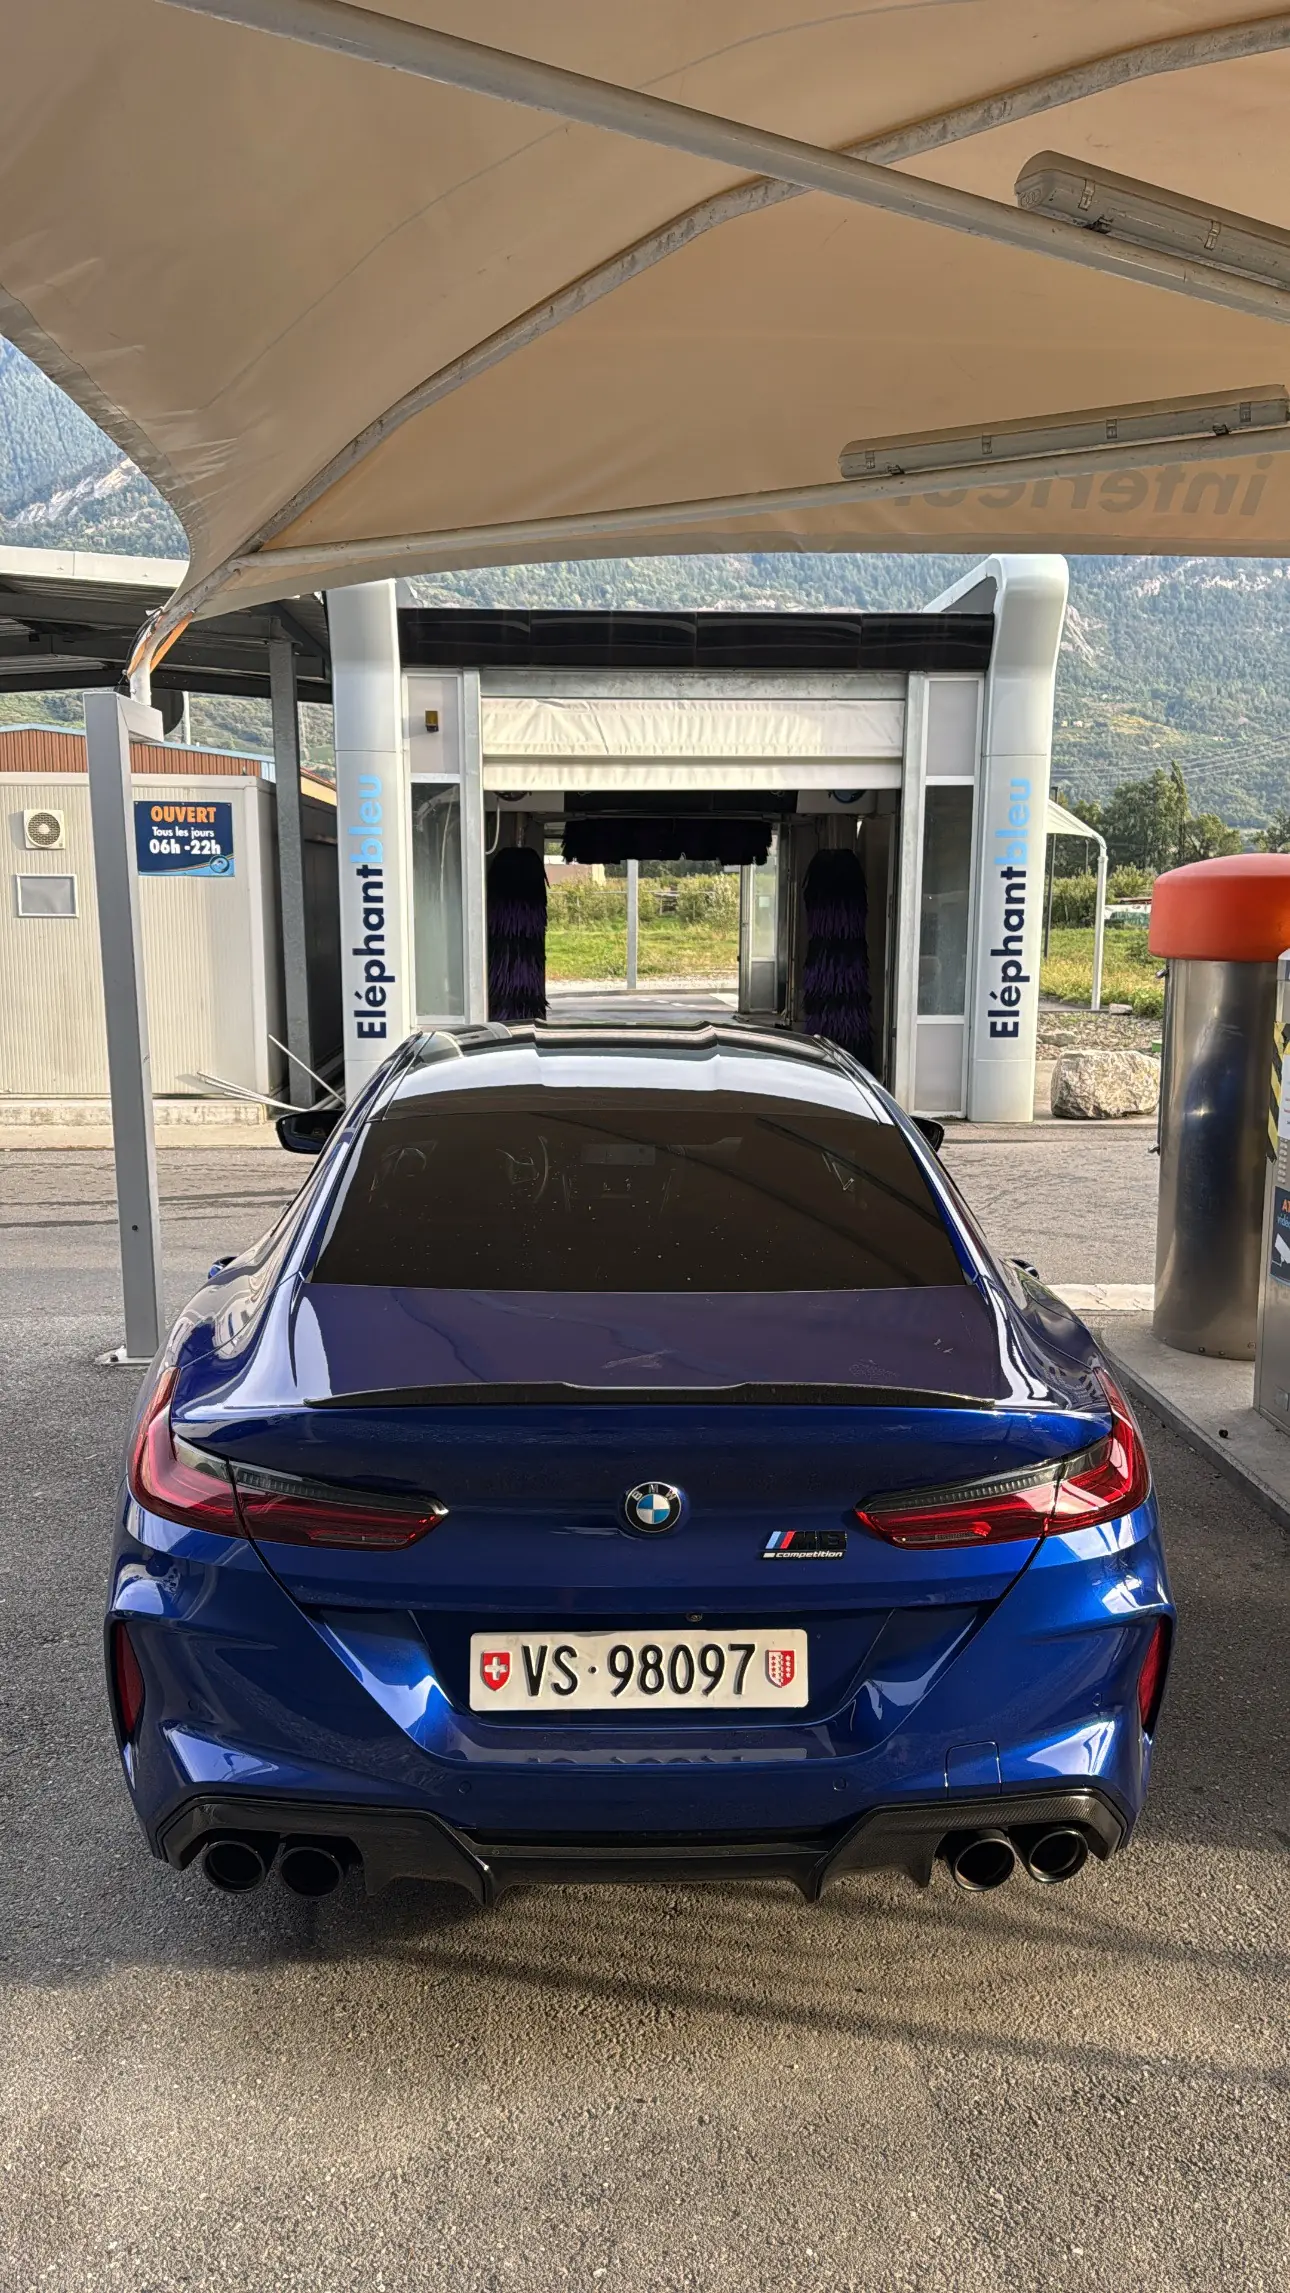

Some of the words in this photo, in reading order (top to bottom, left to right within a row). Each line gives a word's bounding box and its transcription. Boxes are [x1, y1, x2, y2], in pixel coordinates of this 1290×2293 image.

[150, 805, 217, 823] OUVERT
[152, 826, 173, 837] Tous
[175, 826, 189, 837] les
[190, 827, 215, 840] jours
[149, 838, 181, 854] 06h
[631, 1484, 677, 1501] BMW
[775, 1550, 843, 1559] competition
[520, 1644, 579, 1697] VS
[606, 1643, 757, 1698] 98097
